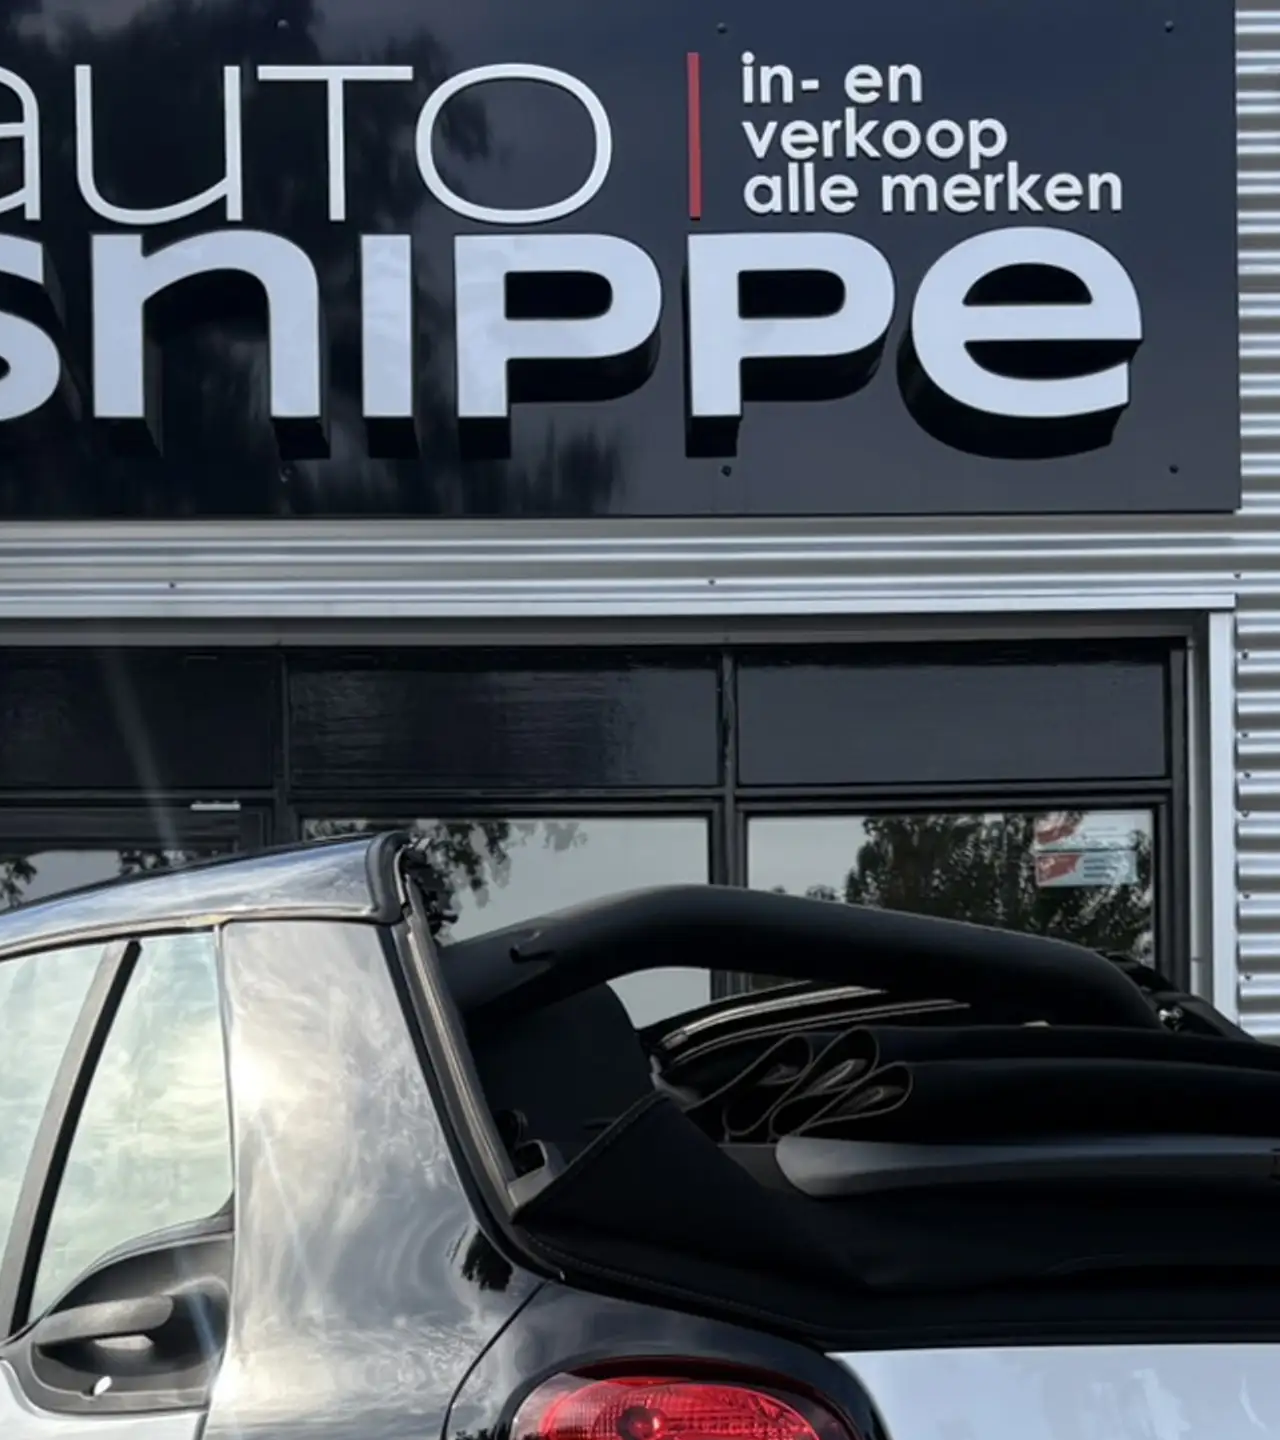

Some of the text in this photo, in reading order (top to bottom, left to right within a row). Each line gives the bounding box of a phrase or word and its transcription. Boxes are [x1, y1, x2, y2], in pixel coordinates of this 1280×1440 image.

[741, 51, 923, 104] in- en
[741, 107, 1008, 170] verkoop
[743, 161, 1123, 214] alle merken
